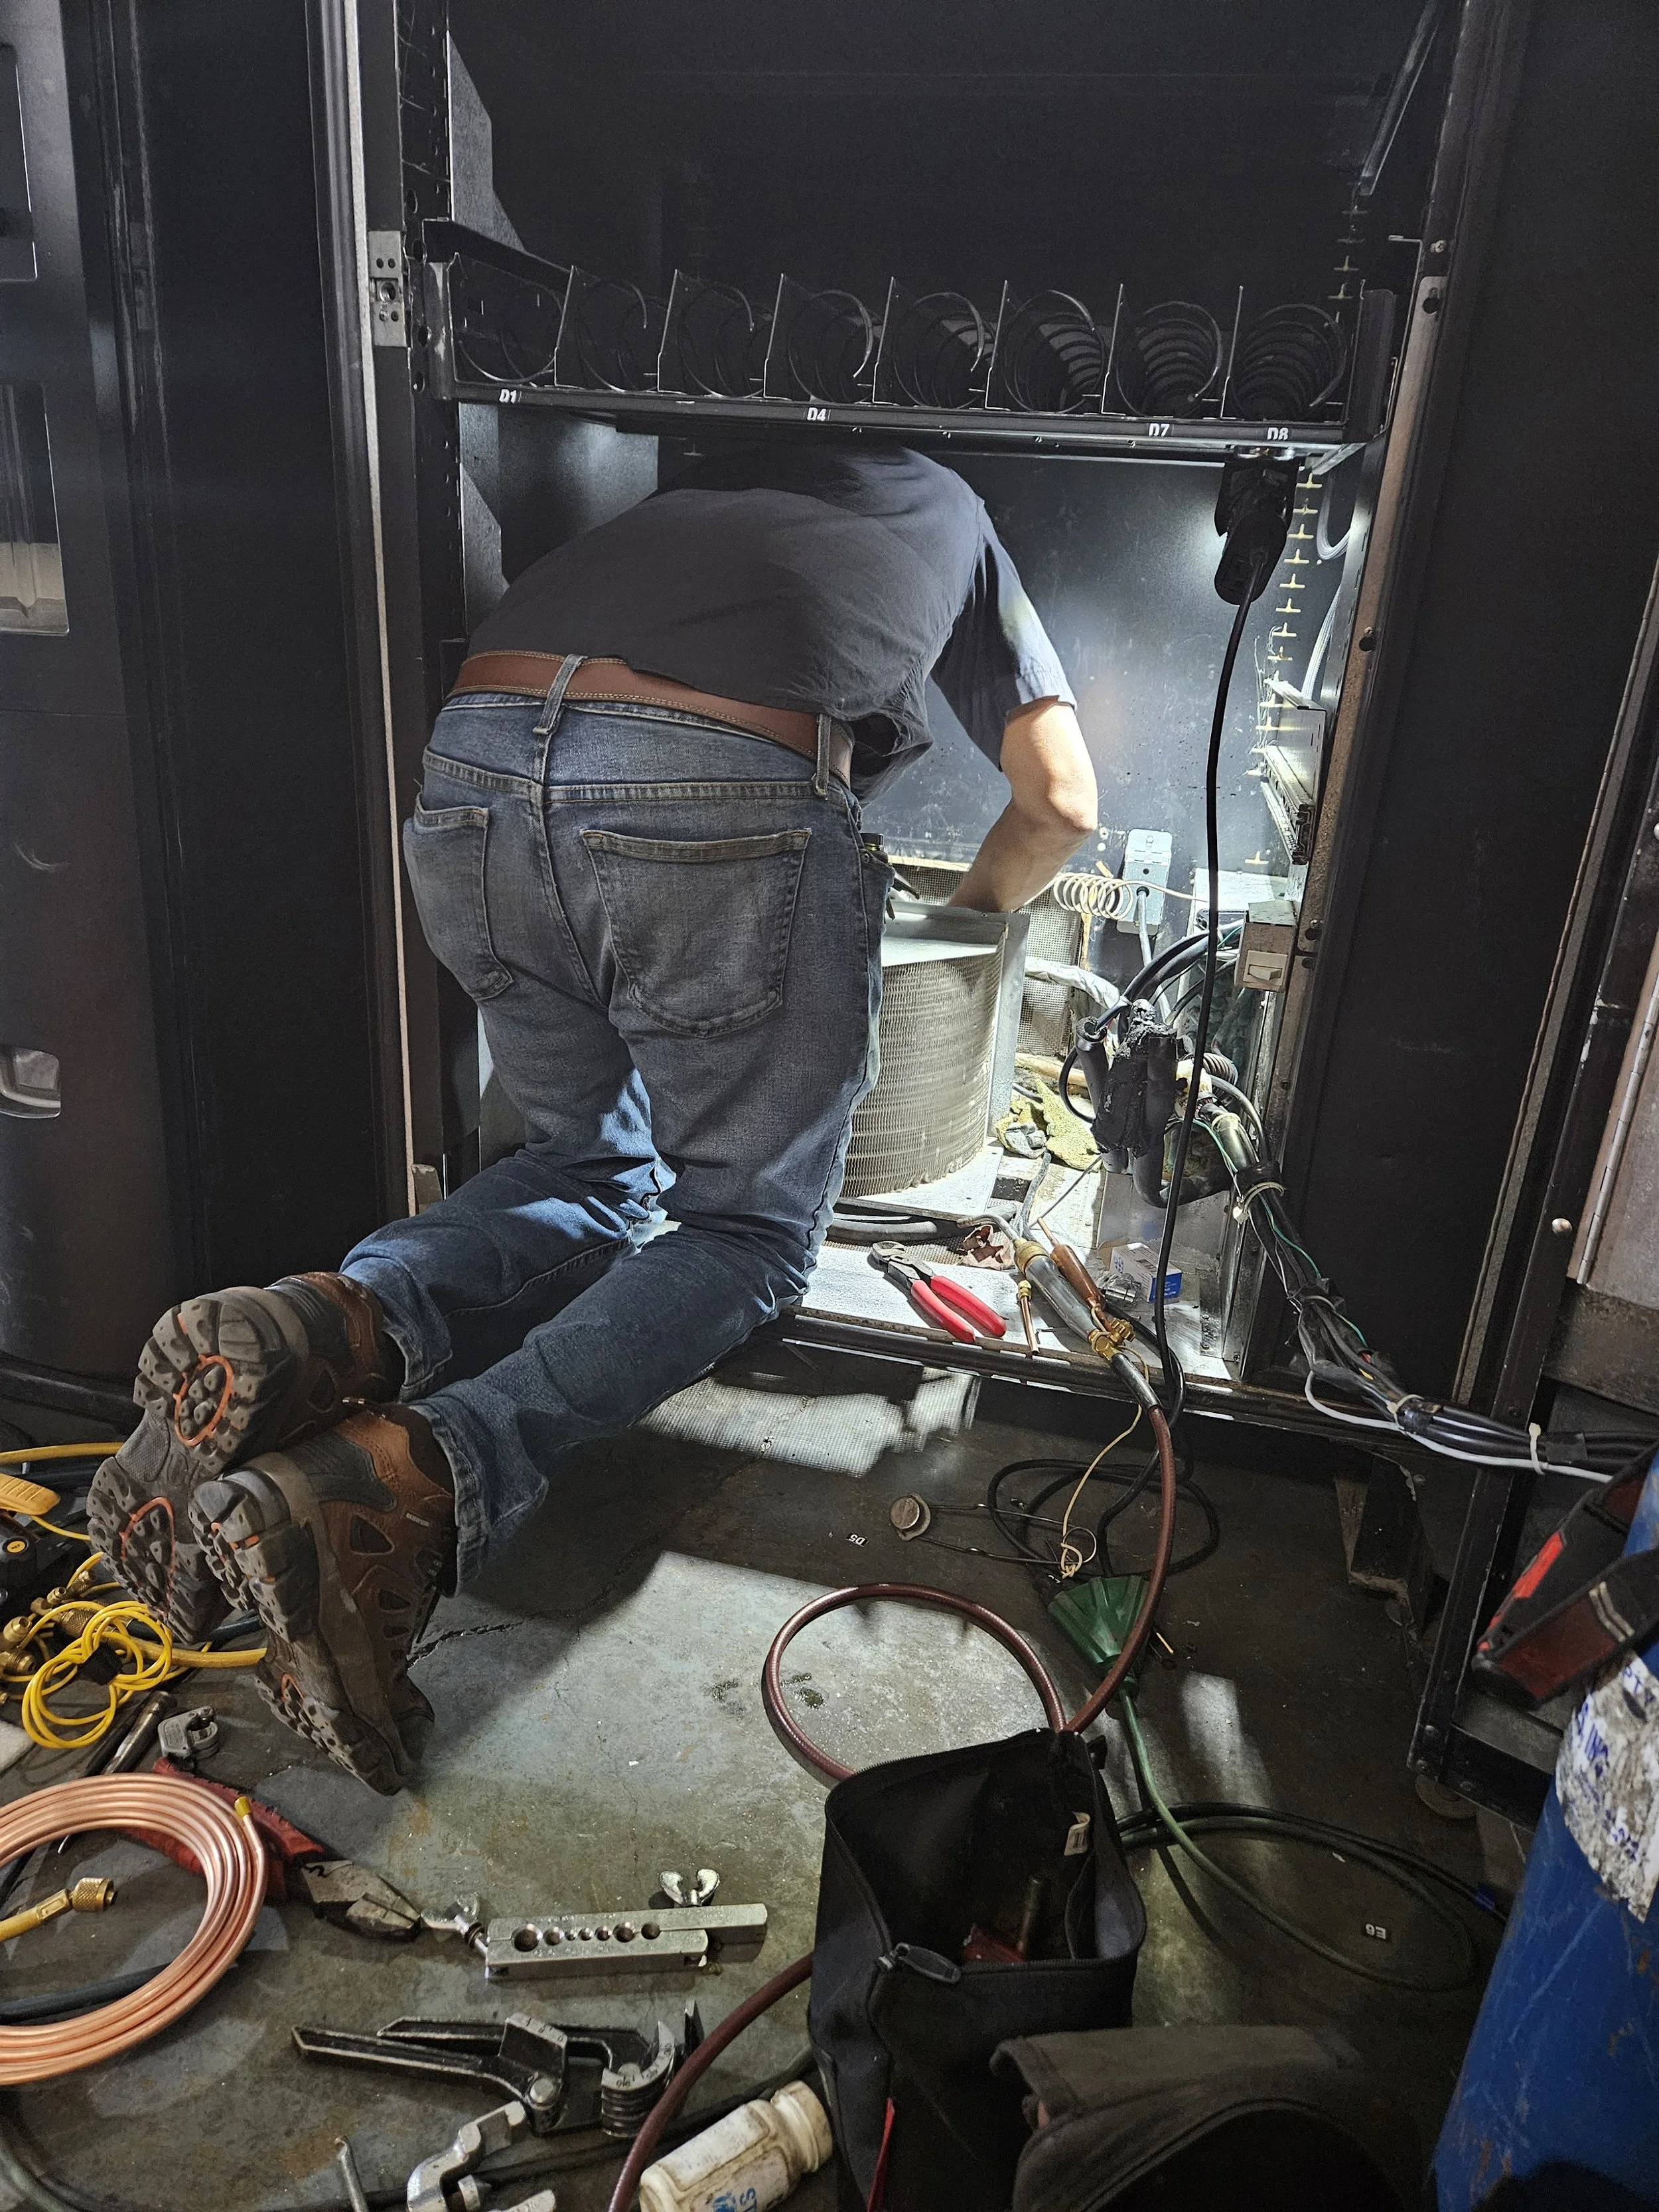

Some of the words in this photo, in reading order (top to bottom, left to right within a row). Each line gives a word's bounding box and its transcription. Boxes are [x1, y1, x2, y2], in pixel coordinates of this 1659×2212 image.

[499, 389, 517, 404] D1
[807, 407, 827, 421] D4
[1149, 423, 1170, 437] D7
[1267, 427, 1288, 440] D8
[848, 1534, 866, 1546] D5
[1365, 1923, 1386, 1939] E6
